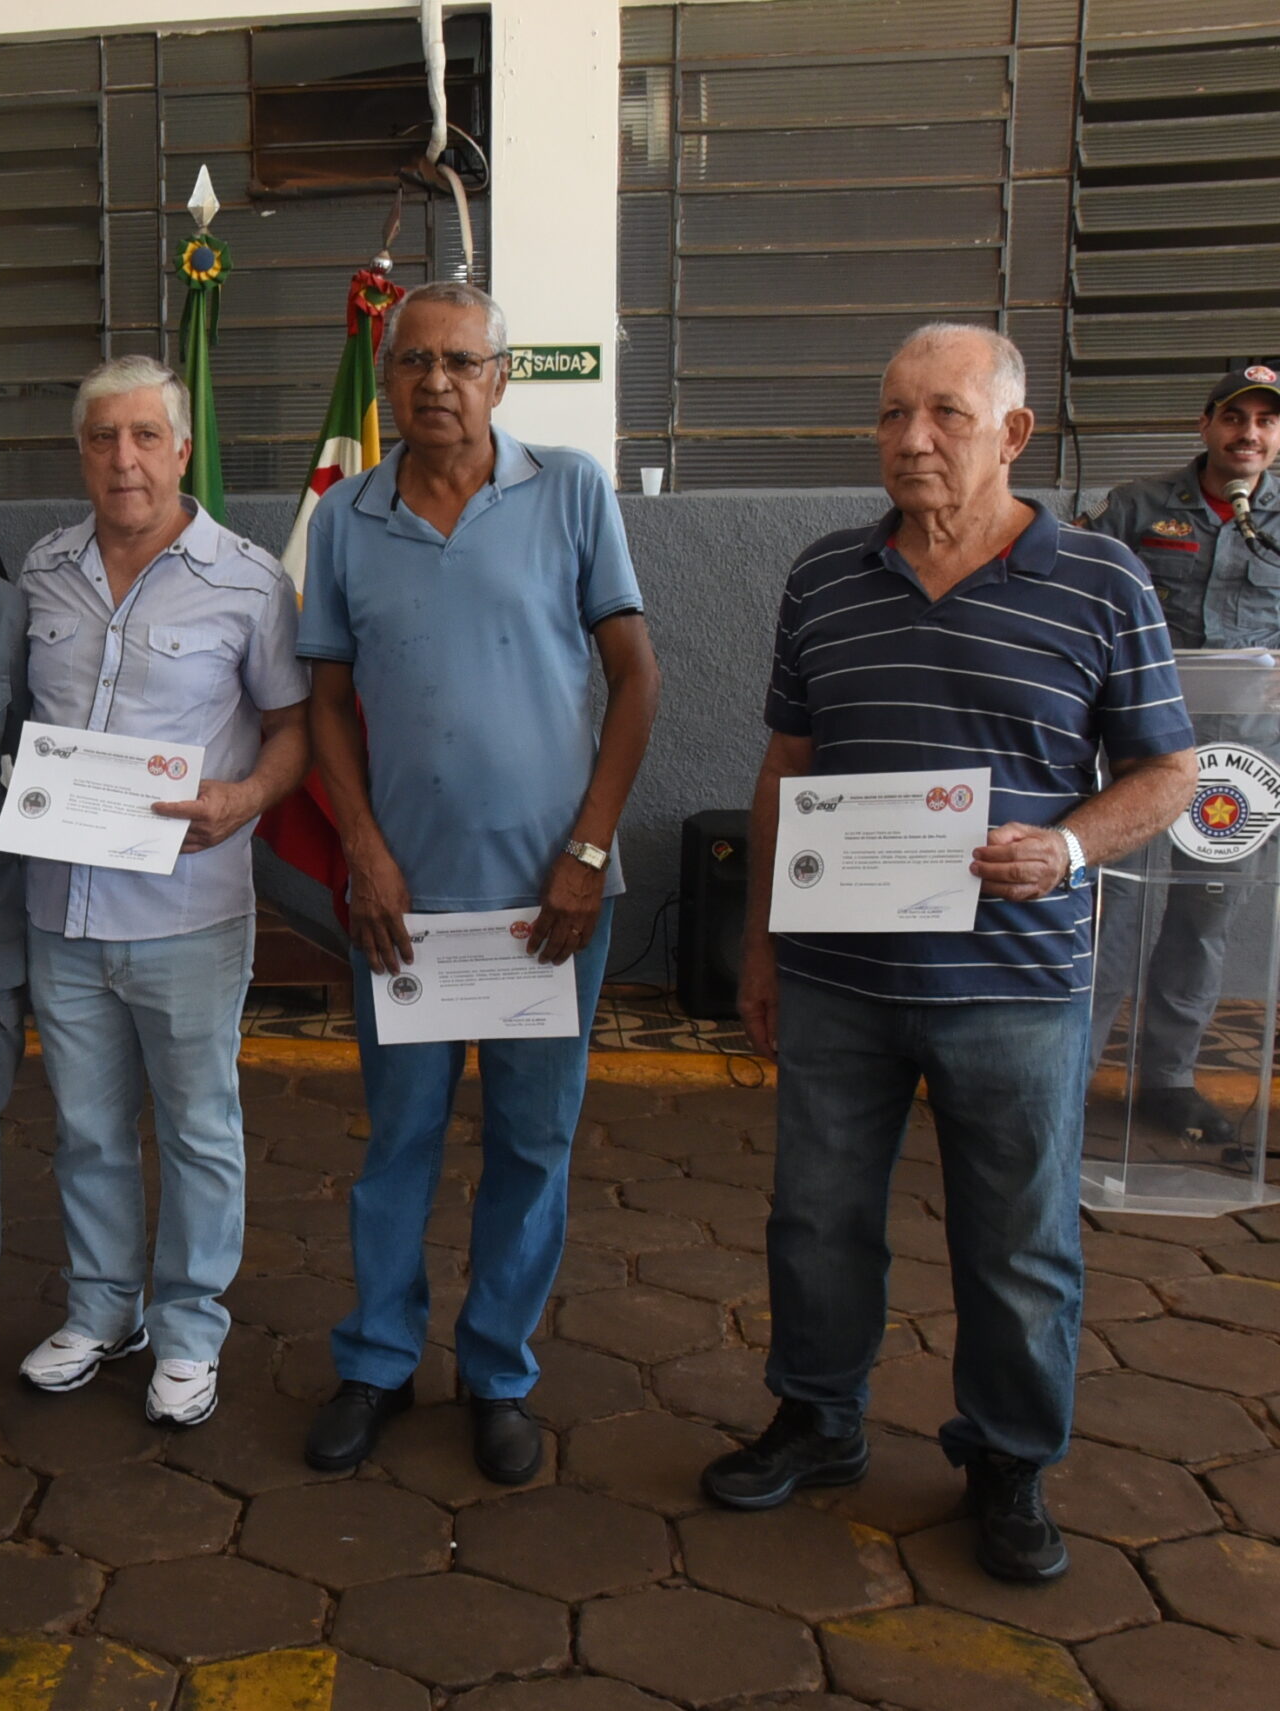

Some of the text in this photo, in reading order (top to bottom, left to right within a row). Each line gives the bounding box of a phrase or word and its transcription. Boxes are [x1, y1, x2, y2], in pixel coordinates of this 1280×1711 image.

[533, 351, 581, 372] SAÍDA
[1197, 845, 1240, 856] SÃO PAULO
